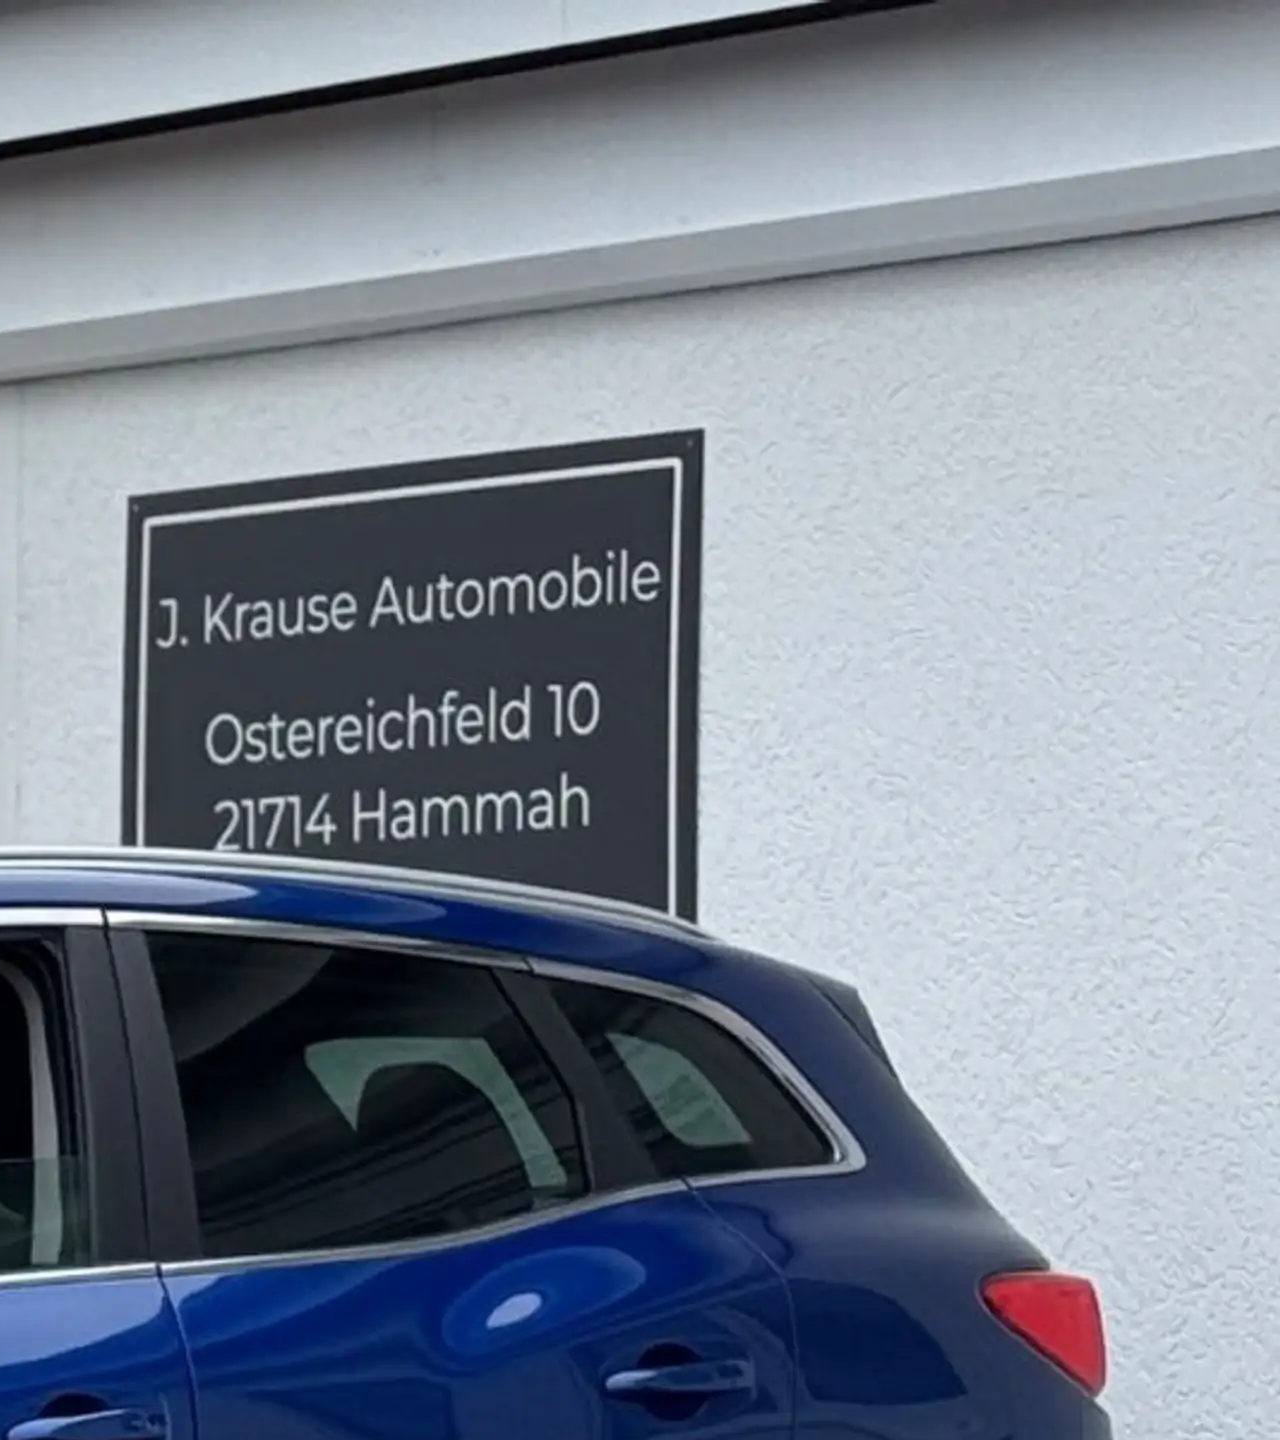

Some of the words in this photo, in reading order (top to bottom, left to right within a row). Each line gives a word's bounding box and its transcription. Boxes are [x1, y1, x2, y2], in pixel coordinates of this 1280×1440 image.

[155, 597, 189, 649] J.
[203, 591, 359, 645] Krause
[368, 548, 662, 629] Automobile
[204, 685, 533, 766] Ostereichfeld
[546, 680, 601, 737] 10
[212, 792, 338, 852] 21714
[352, 771, 591, 843] Hammah
